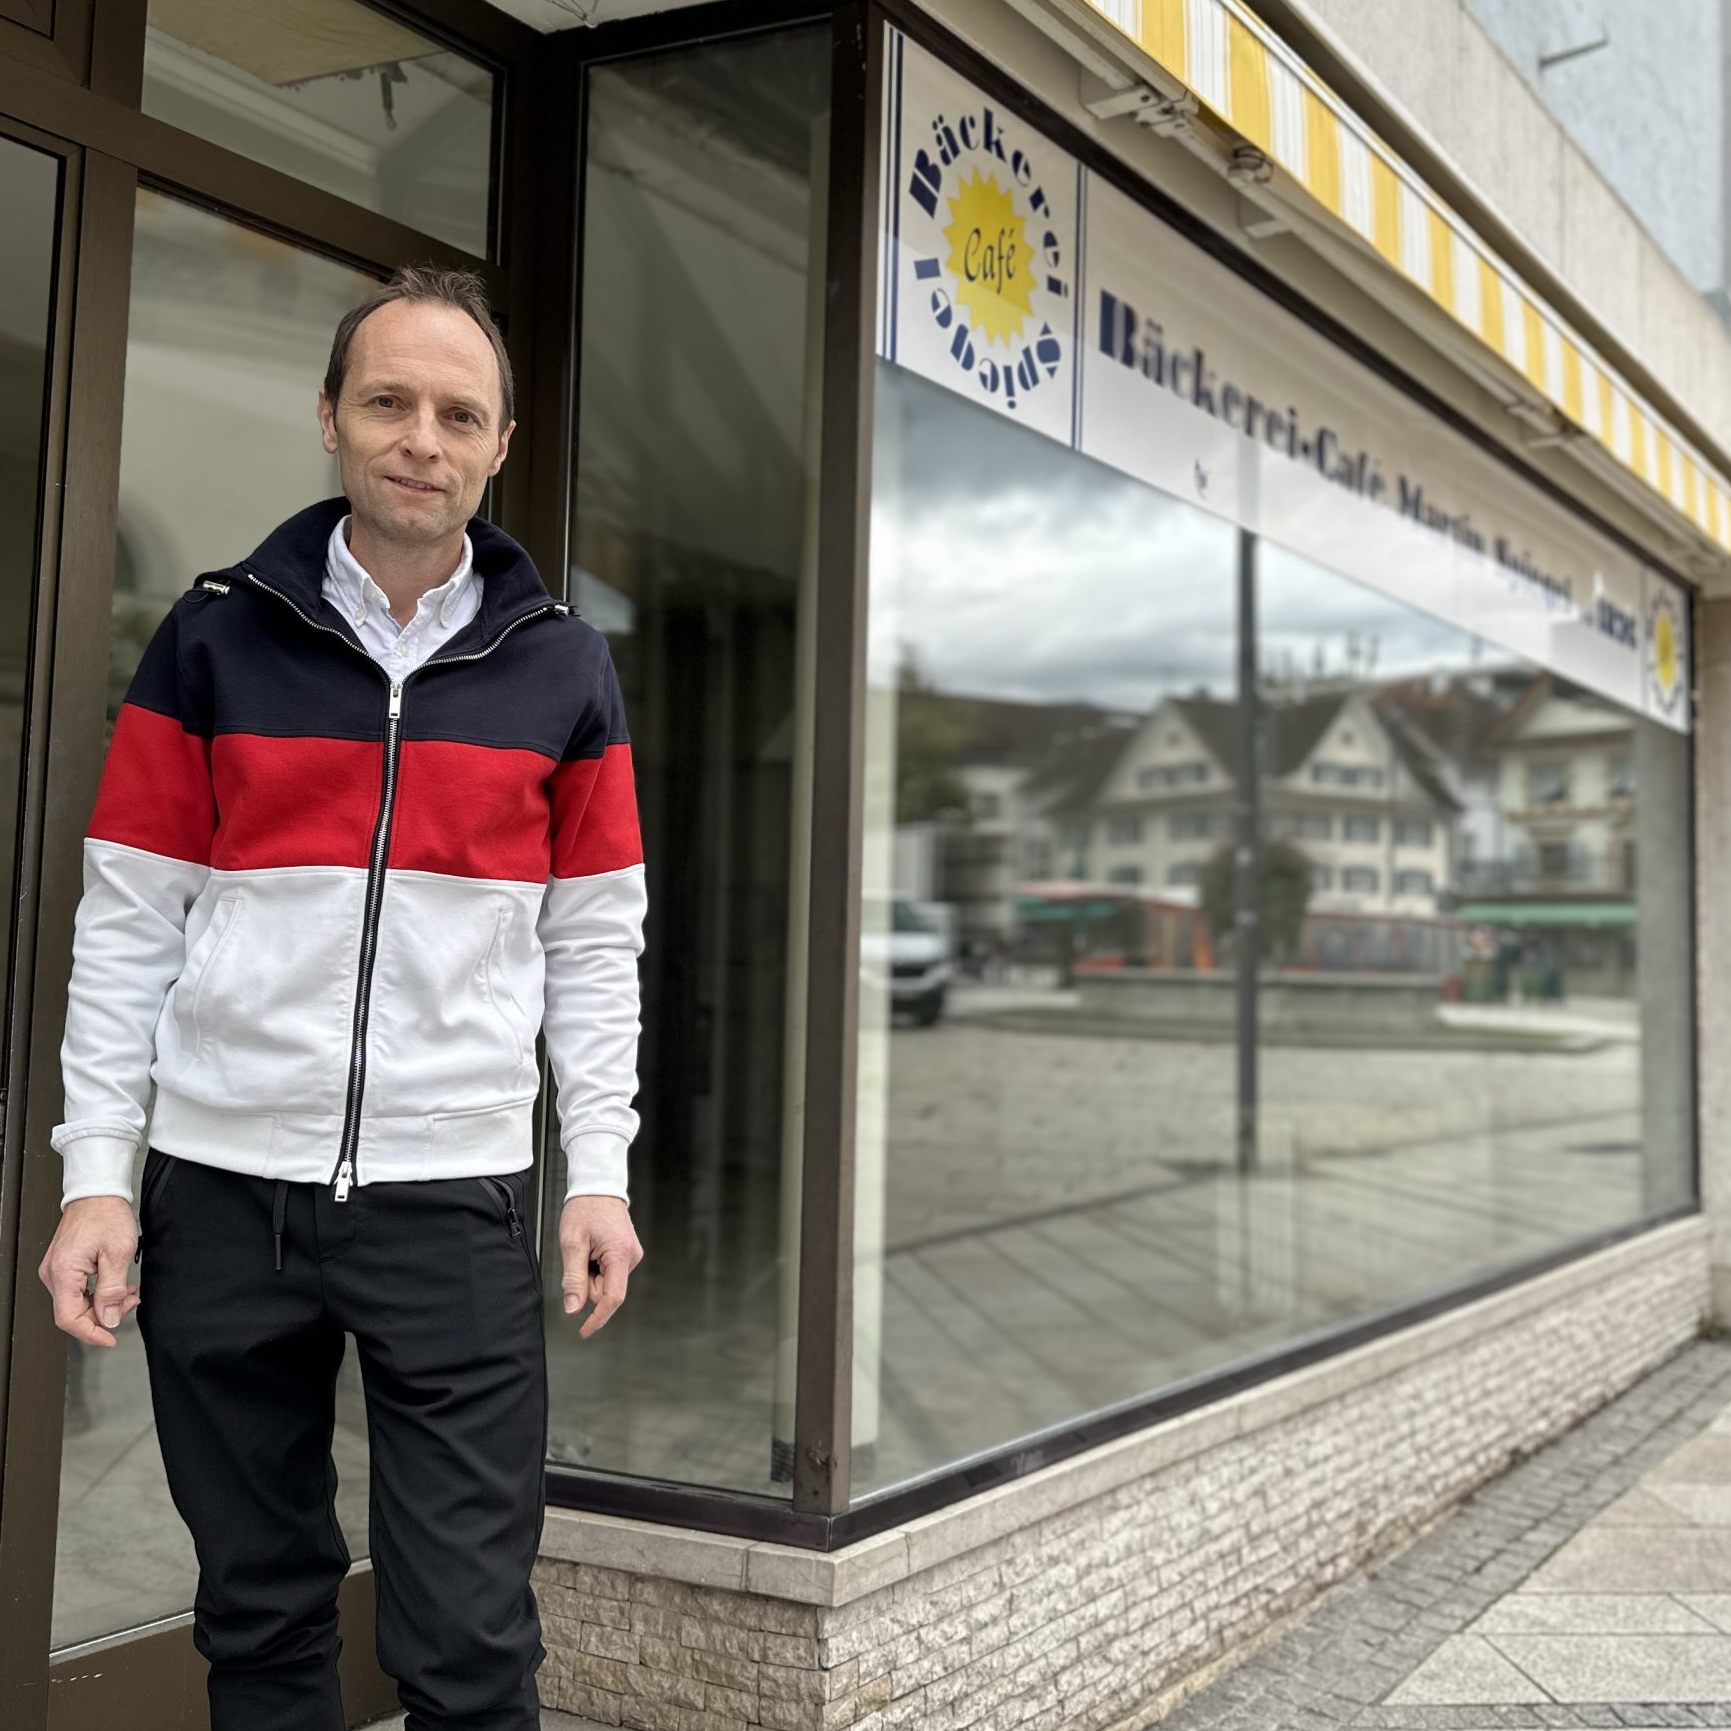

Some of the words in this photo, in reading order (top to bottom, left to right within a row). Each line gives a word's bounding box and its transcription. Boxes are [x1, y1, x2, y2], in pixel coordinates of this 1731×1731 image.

[909, 106, 1068, 299] Bäckerei
[963, 226, 1017, 295] Café
[913, 257, 1062, 410] Spiegel
